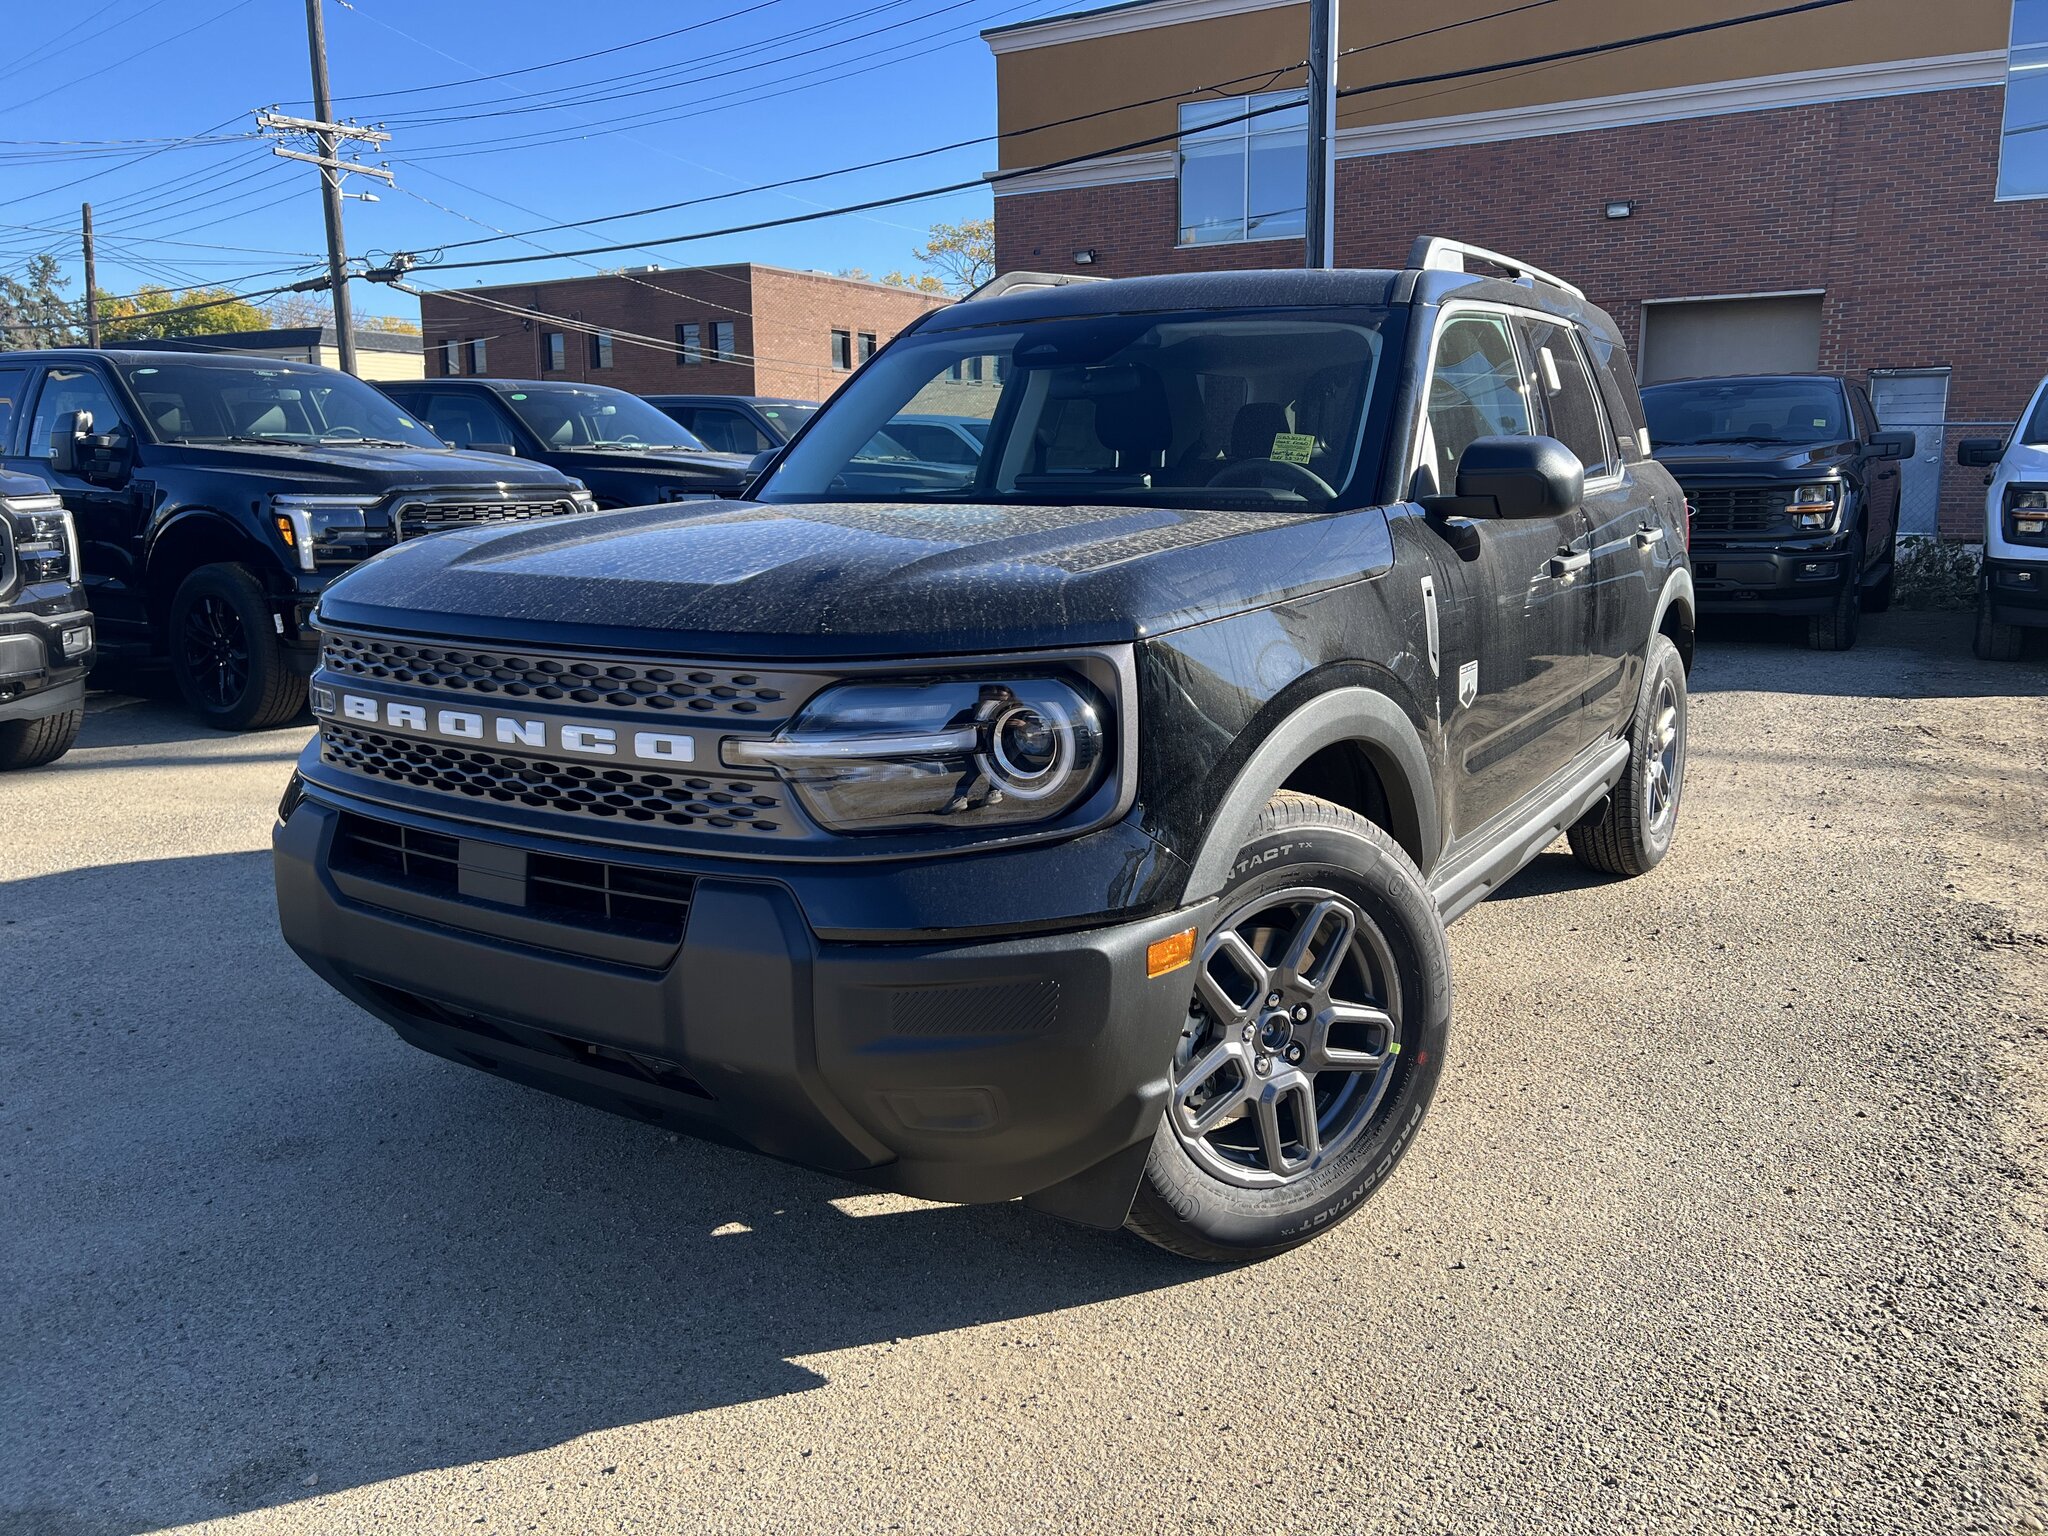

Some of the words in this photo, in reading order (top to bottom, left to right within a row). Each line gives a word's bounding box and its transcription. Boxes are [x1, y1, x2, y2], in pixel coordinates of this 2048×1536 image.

[343, 694, 695, 763] BRONCO
[1226, 843, 1294, 880] NTACT
[1299, 1103, 1422, 1231] PROCONTACT
